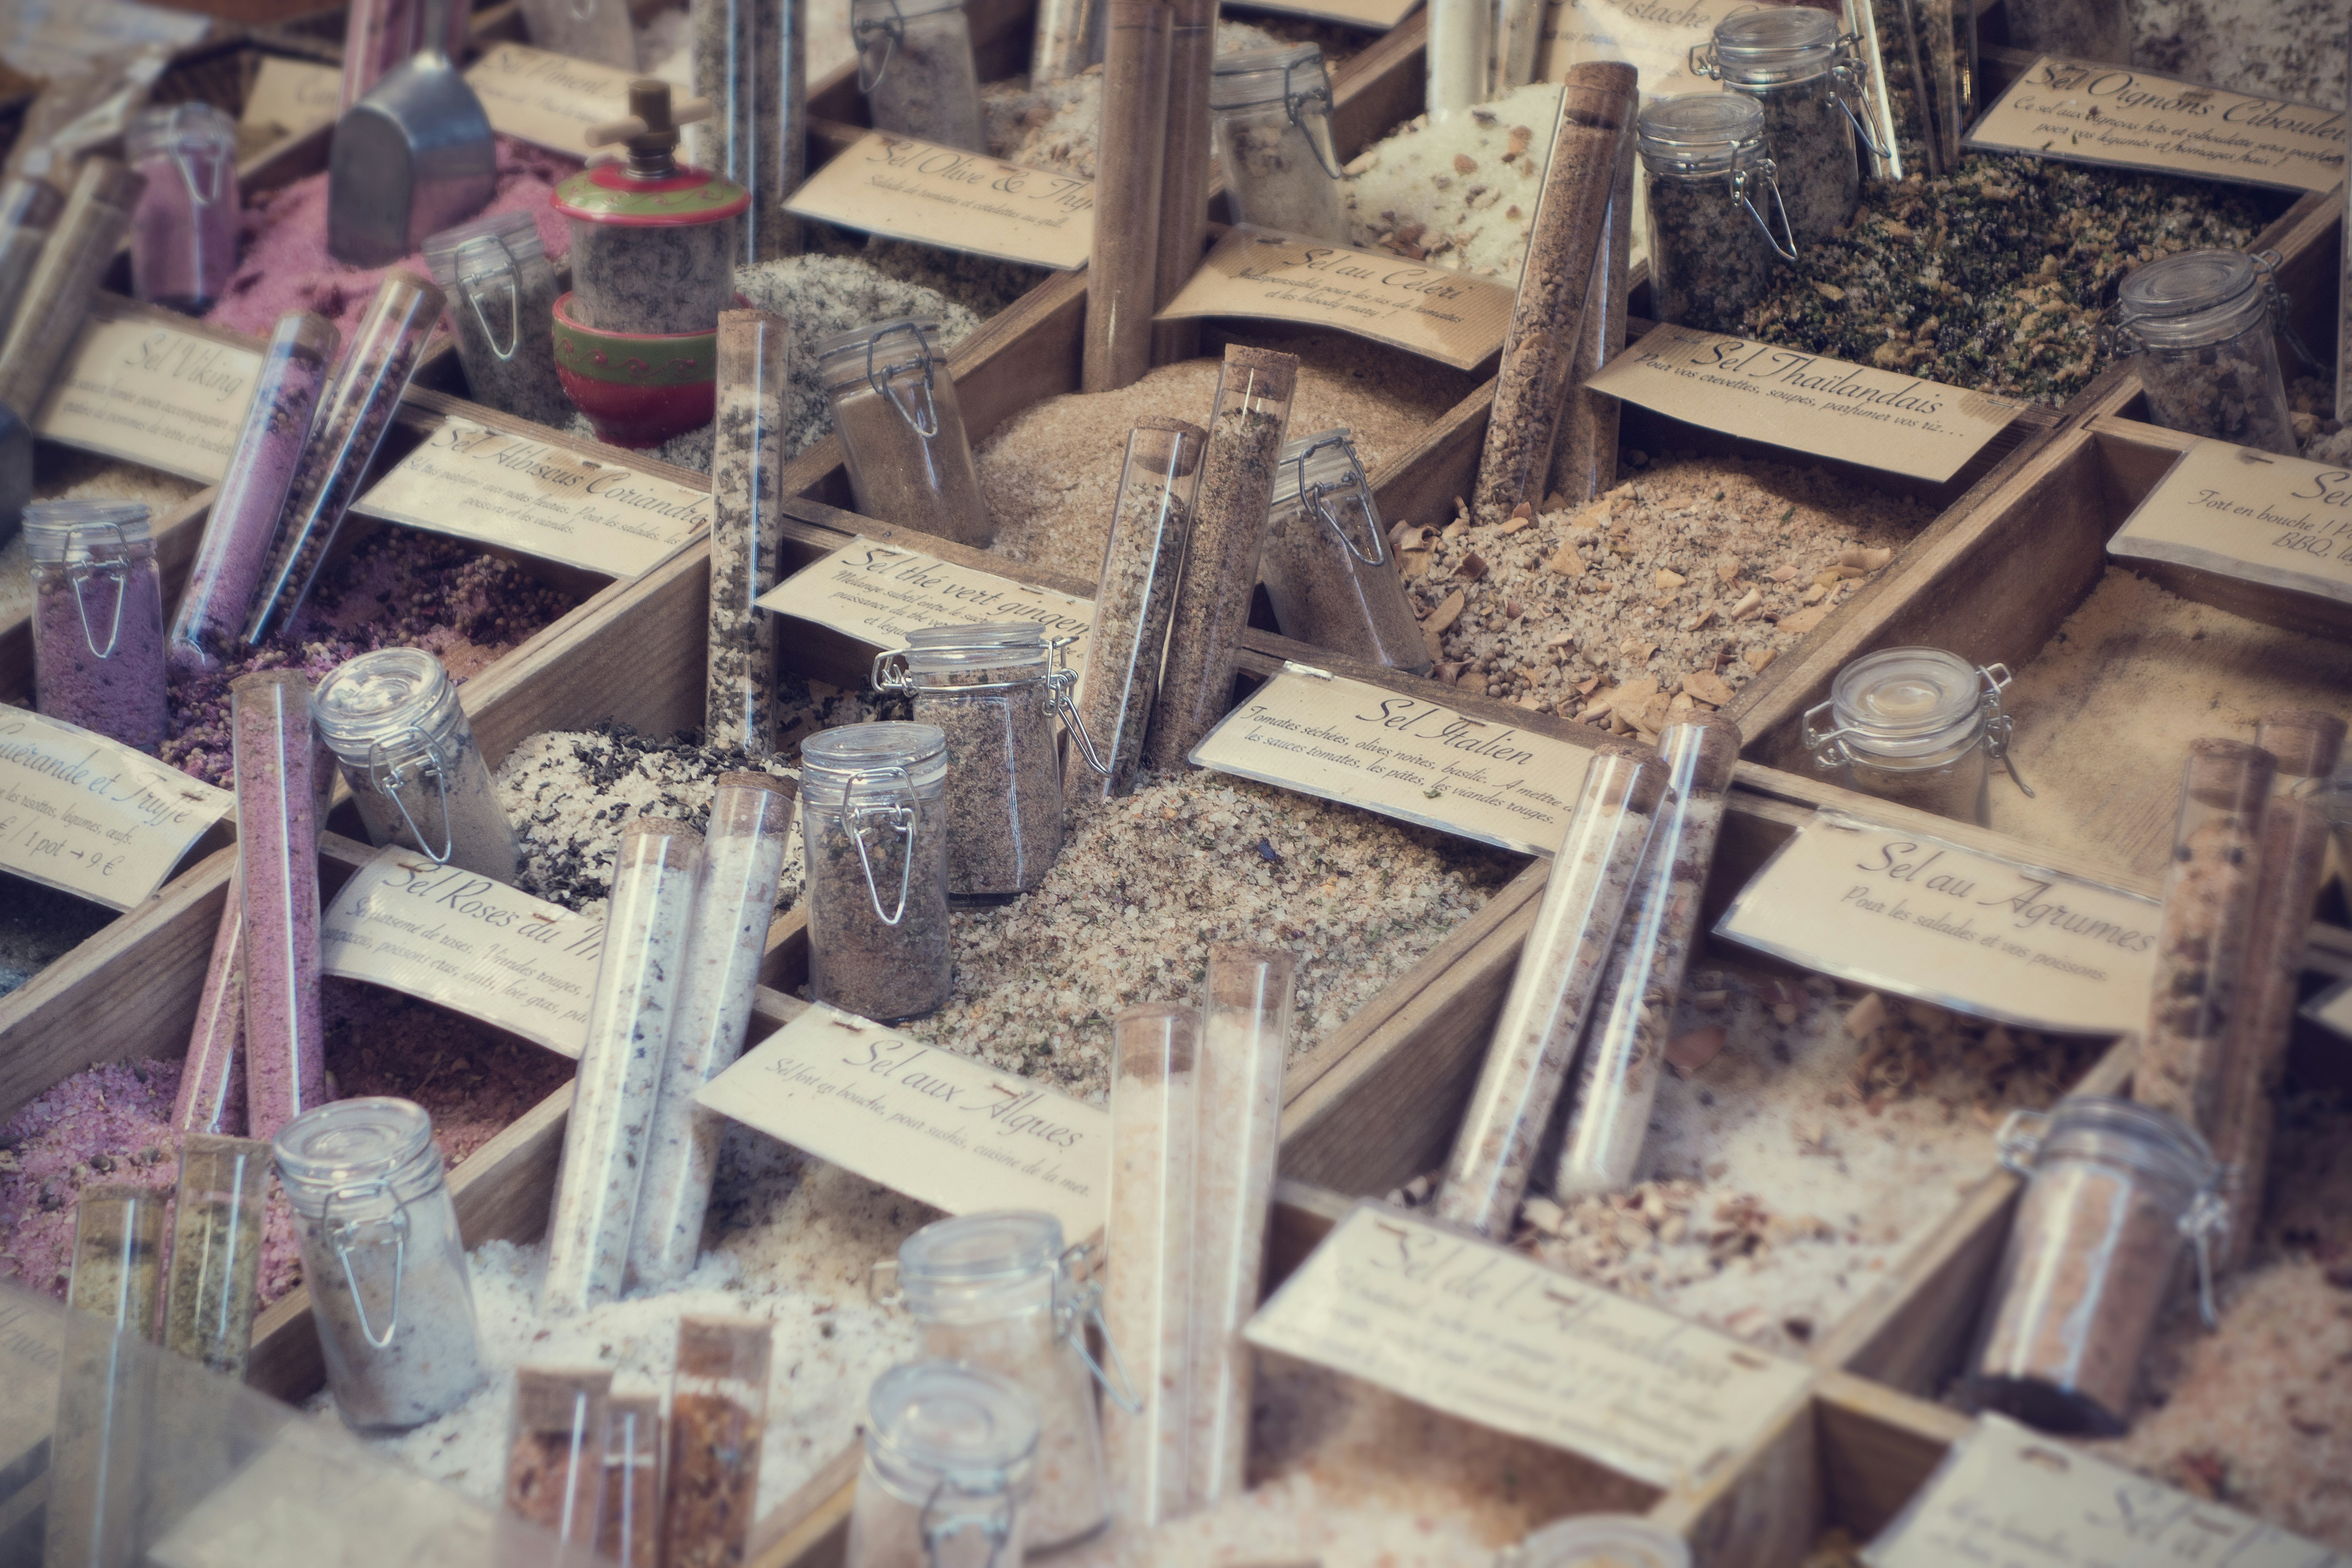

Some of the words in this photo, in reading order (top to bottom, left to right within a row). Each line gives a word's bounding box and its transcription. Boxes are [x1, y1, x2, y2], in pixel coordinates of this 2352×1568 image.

[525, 57, 612, 94] Piment
[2025, 64, 2089, 90] Sel
[2088, 72, 2214, 116] Oignons
[2035, 100, 2065, 114] sel
[2171, 128, 2188, 136] et
[865, 142, 932, 167] Sel
[918, 153, 985, 184] Olive
[992, 172, 1030, 193] &
[2160, 138, 2234, 160] fromages
[864, 174, 907, 192] Salade
[903, 183, 922, 194] de
[919, 190, 959, 204] tomates
[1283, 248, 1352, 271] Sel
[1335, 266, 1375, 279] au
[1381, 269, 1473, 300] Céleri
[1279, 288, 1298, 300] les
[1298, 291, 1346, 310] bloody
[1310, 286, 1351, 296] pour
[1352, 288, 1372, 300] les
[1392, 299, 1415, 309] de
[125, 333, 183, 372] Sel
[173, 342, 244, 402] Viking
[1690, 341, 1769, 372] Sel
[1748, 352, 1943, 413] Thaïlandais
[1633, 352, 1671, 371] Pour
[1675, 367, 1698, 378] vos
[1700, 374, 1760, 394] crevettes,
[1766, 388, 1816, 407] soupes,
[1818, 401, 1891, 422] parfumer
[1894, 415, 1919, 427] vos
[431, 428, 495, 453] Sel
[472, 442, 584, 486] Hibiscus
[586, 472, 710, 524] Coriandre
[503, 490, 532, 502] notes
[574, 506, 603, 523] Pour
[602, 514, 619, 527] les
[618, 522, 661, 541] salades,
[663, 532, 682, 545] les
[518, 508, 535, 521] les
[534, 517, 575, 534] viandes.
[2187, 489, 2233, 511] Fort
[2233, 504, 2254, 516] en
[2256, 505, 2316, 532] bouche
[2272, 532, 2334, 557] BBQ,
[830, 570, 885, 592] Mélange
[883, 590, 929, 603] subtil
[917, 600, 949, 612] entre
[949, 606, 967, 616] le
[841, 548, 920, 574] Sel
[894, 564, 949, 588] thé
[943, 584, 1004, 605] vert
[828, 591, 889, 610] puissance
[888, 604, 911, 616] du
[906, 610, 930, 622] thé
[863, 616, 881, 625] et
[1355, 698, 1438, 731] Sel
[1414, 715, 1534, 765] Italien
[1240, 706, 1301, 731] Tomates
[1300, 725, 1349, 746] séchées,
[1355, 737, 1393, 756] olives
[1393, 750, 1435, 769] noires,
[1441, 761, 1487, 784] basilic.
[1492, 779, 1524, 790] A
[1516, 787, 1562, 806] mettre
[1244, 725, 1263, 742] les
[1263, 737, 1307, 753] sauces
[1306, 746, 1360, 769] tomates,
[1366, 757, 1386, 773] les
[1381, 766, 1425, 786] pâtes,
[1430, 776, 1452, 792] les
[1452, 786, 1505, 807] viandes
[1506, 801, 1554, 824] rouges.
[5, 781, 21, 803] les
[21, 793, 57, 818] risottos,
[61, 802, 103, 834] légumes,
[88, 773, 121, 795] et
[111, 771, 211, 826] Truffe
[25, 830, 40, 846] 1
[31, 838, 67, 858] pot
[103, 856, 125, 876] €
[382, 862, 463, 897] Sel
[436, 877, 520, 928] Roses
[517, 911, 571, 943] du
[1856, 841, 1945, 882] Sel
[1926, 871, 1976, 899] au
[1977, 874, 2157, 953] Agrumes
[1840, 885, 1886, 913] Pour
[1887, 898, 1912, 921] les
[1912, 911, 1978, 941] salades
[1979, 931, 2001, 948] et
[2000, 940, 2031, 959] vos
[2028, 948, 2109, 983] poissons.
[372, 941, 432, 964] poissons
[431, 960, 459, 977] crus,
[520, 996, 560, 1014] gras,
[420, 923, 447, 940] de
[440, 934, 472, 954] roses.
[482, 943, 538, 977] Viandes
[536, 972, 582, 996] rouges,
[765, 1058, 805, 1076] Sel
[782, 1066, 822, 1086] fort
[816, 1082, 837, 1093] en
[836, 1082, 887, 1115] bouche,
[842, 1039, 928, 1076] Sel
[900, 1069, 964, 1104] aux
[958, 1090, 1084, 1148] Algues
[885, 1112, 925, 1130] pour
[924, 1126, 968, 1149] sushis,
[973, 1144, 1022, 1168] cuisine
[1021, 1158, 1047, 1175] de
[1041, 1164, 1063, 1182] la
[1059, 1178, 1090, 1197] mer.
